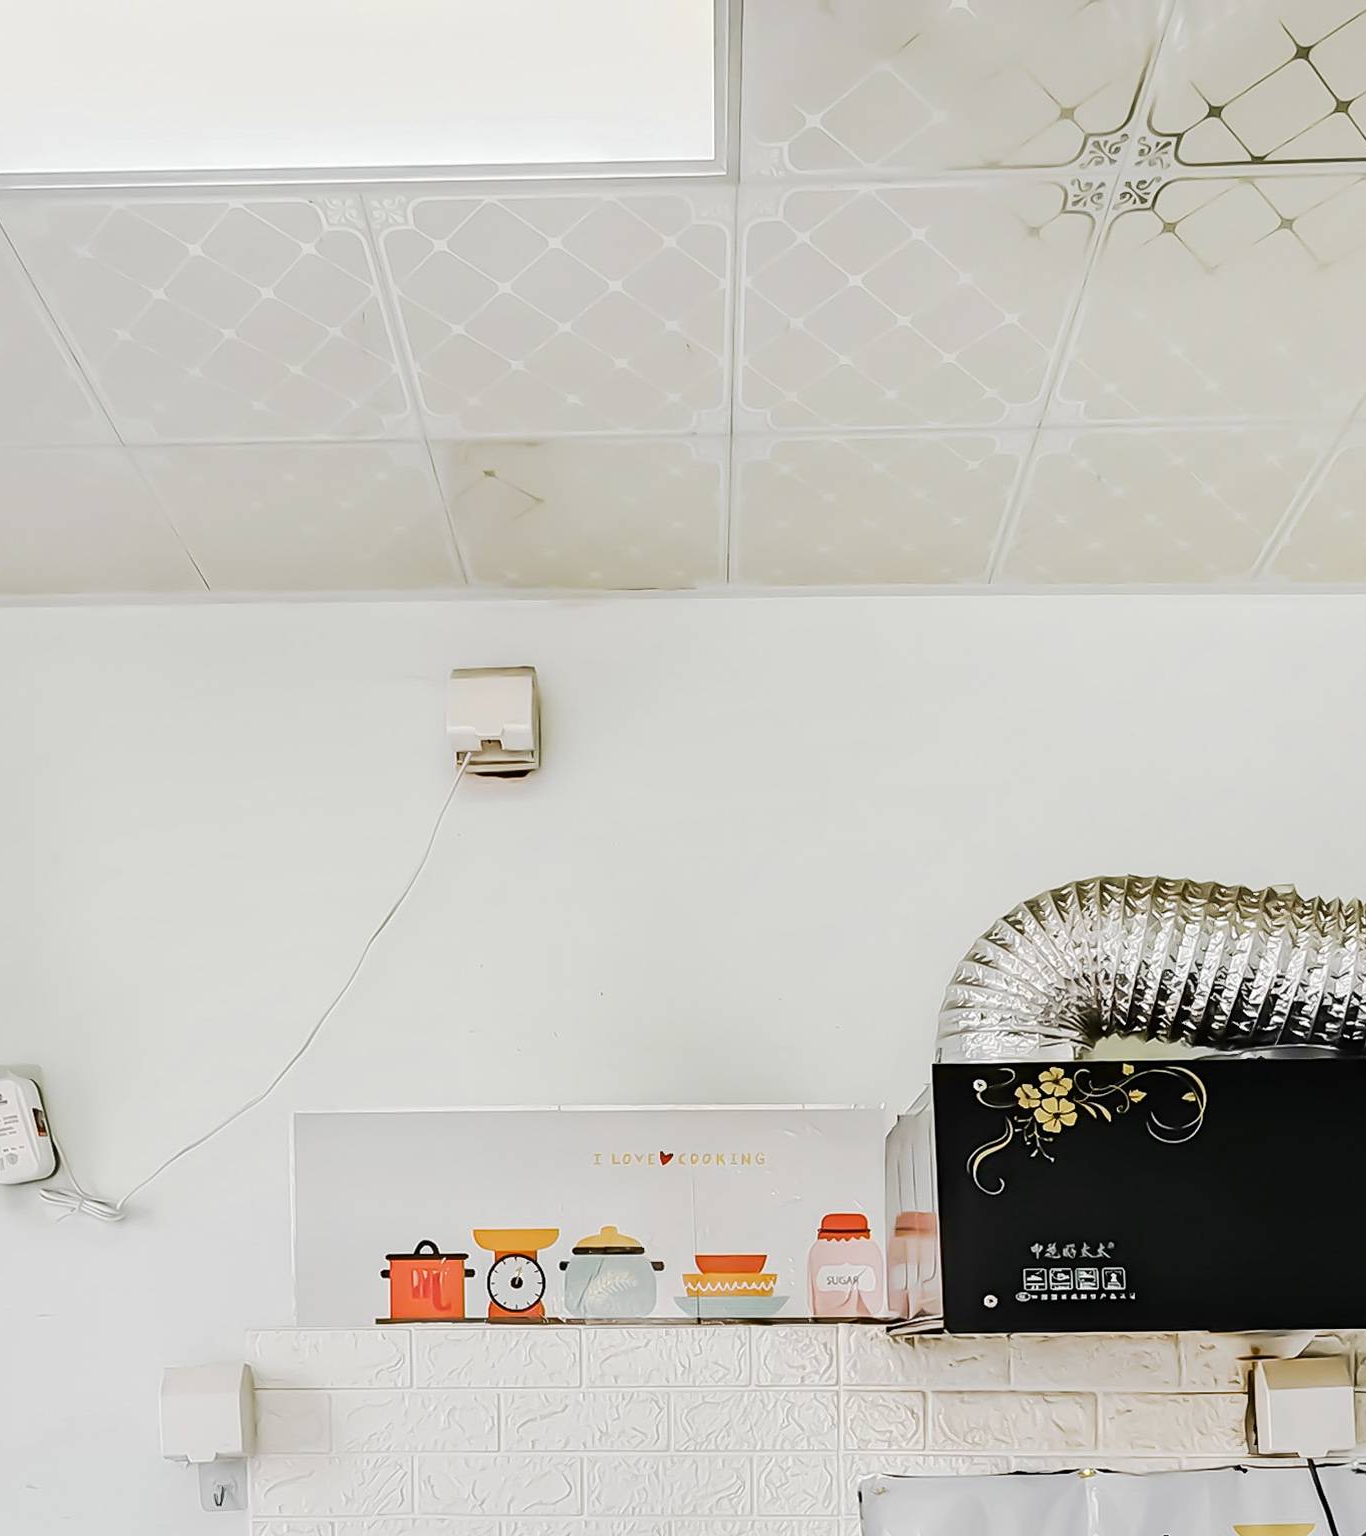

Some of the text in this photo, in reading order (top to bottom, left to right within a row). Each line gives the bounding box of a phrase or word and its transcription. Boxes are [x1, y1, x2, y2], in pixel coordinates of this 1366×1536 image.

[593, 1152, 766, 1166] I LOVE COOKING
[826, 1275, 860, 1286] SUGAR
